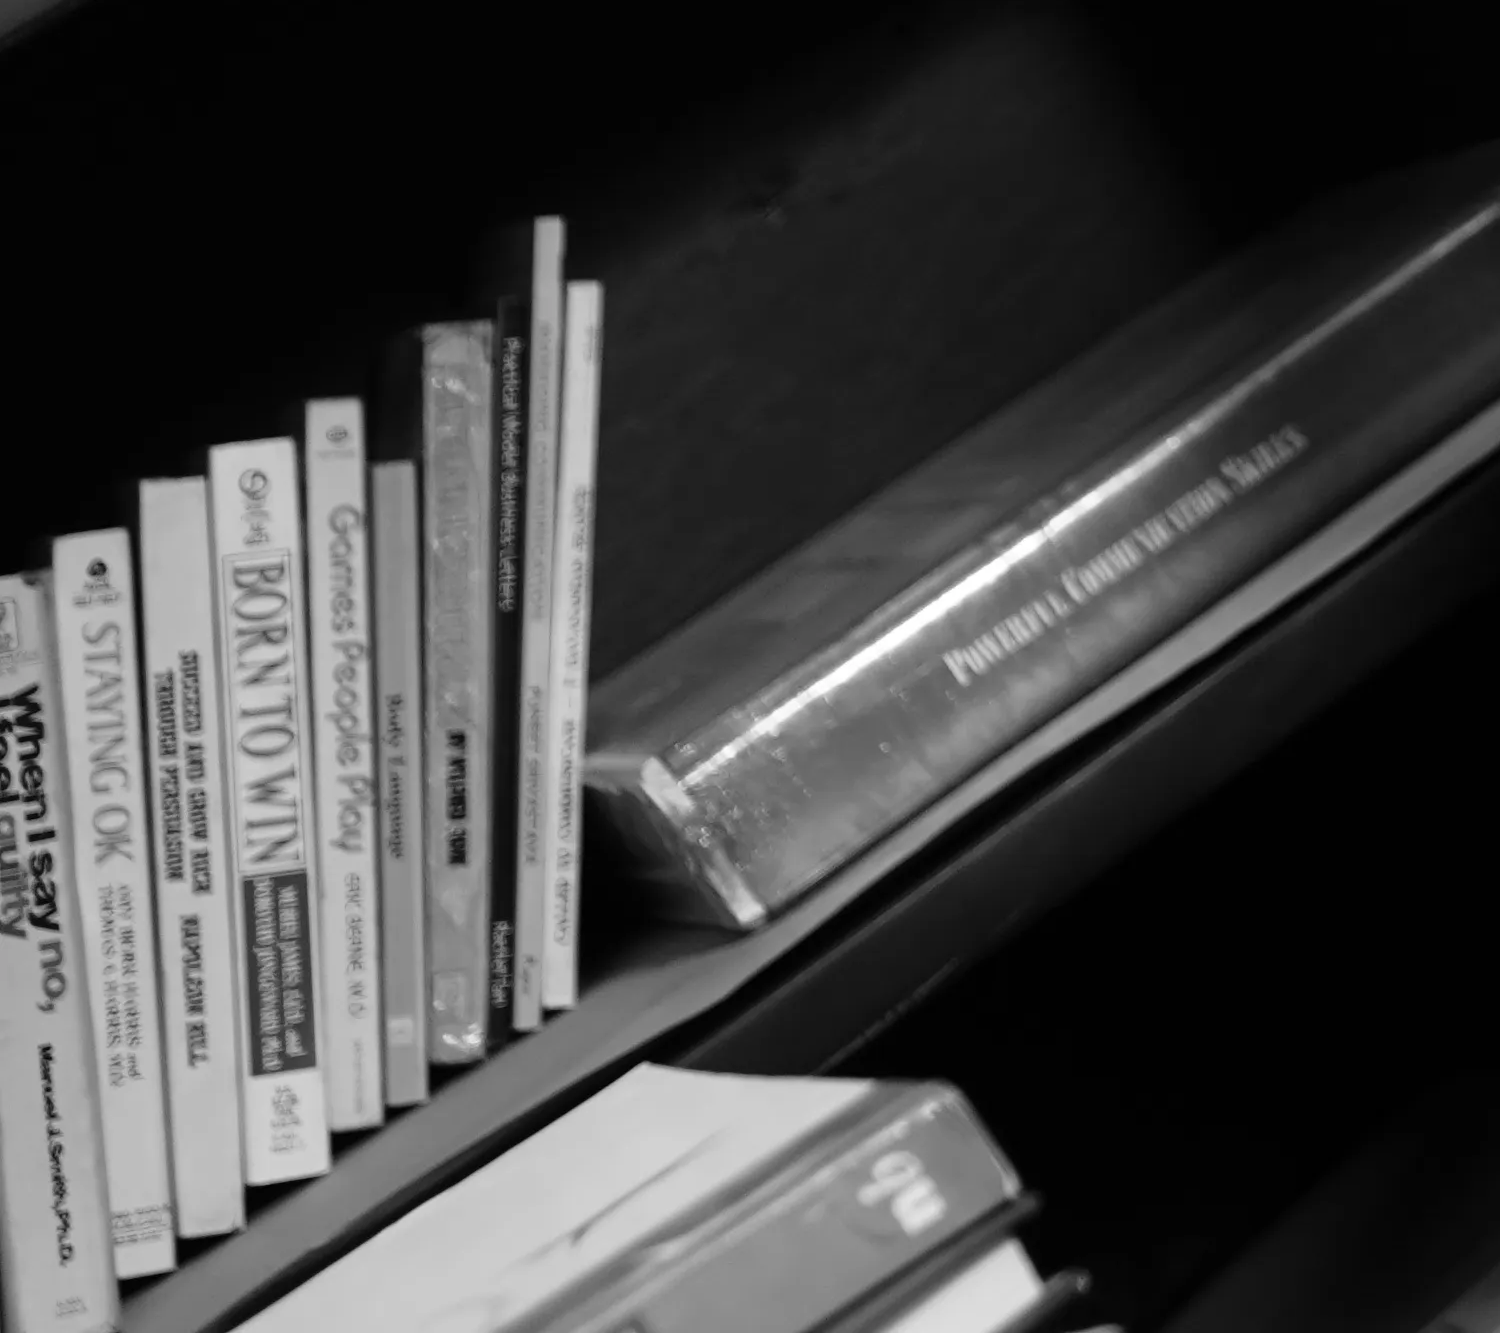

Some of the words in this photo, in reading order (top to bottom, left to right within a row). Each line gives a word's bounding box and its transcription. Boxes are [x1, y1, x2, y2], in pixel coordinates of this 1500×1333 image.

[325, 504, 368, 633] Games
[228, 559, 295, 691] BORN
[77, 619, 131, 794] STAYING
[152, 669, 180, 758] THROUGH
[175, 650, 204, 735] SUCCEED
[237, 696, 297, 761] TO
[321, 639, 373, 767] People
[9, 684, 52, 824] When
[182, 741, 206, 783] AND
[25, 831, 55, 843] I
[90, 804, 136, 868] OK
[157, 763, 187, 882] PERSUASION
[185, 788, 209, 841] GROW
[239, 765, 303, 867] WIN
[325, 773, 378, 853] Play
[22, 850, 63, 933] say
[189, 848, 211, 896] RICH
[34, 940, 69, 1012] no,
[177, 913, 206, 1016] NAPOLEON
[36, 1042, 60, 1118] Manuel
[126, 1051, 143, 1080] and
[184, 1021, 208, 1068] HILL
